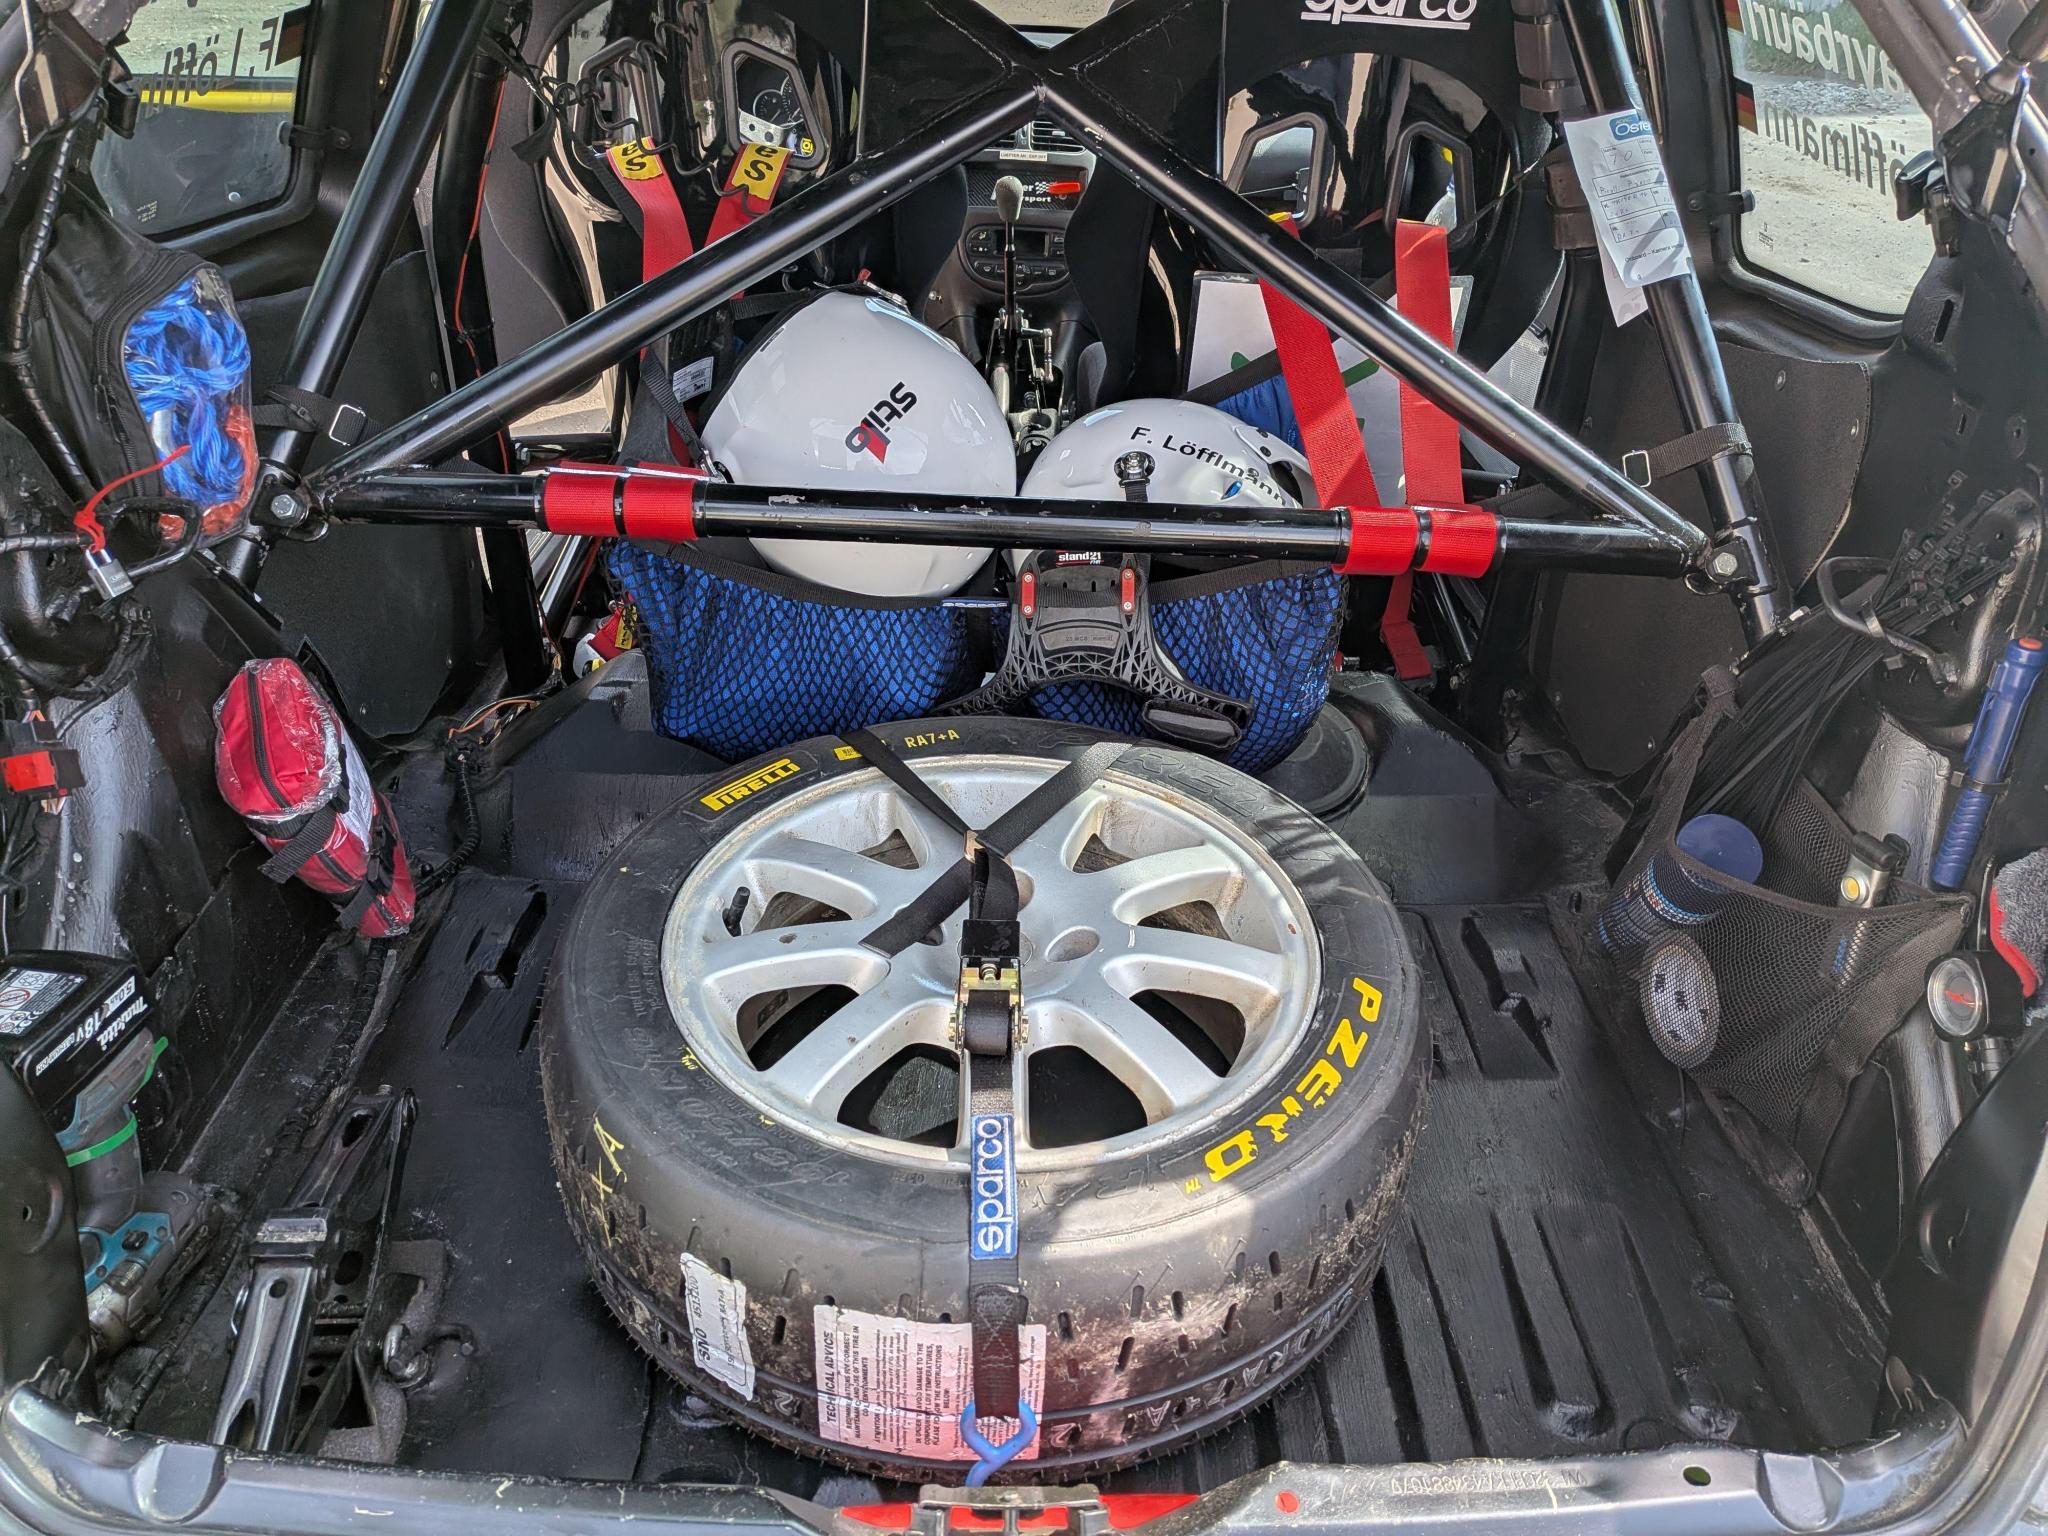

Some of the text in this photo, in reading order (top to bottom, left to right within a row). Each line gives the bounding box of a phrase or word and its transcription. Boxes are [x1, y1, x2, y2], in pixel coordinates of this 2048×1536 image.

[1130, 426, 1287, 507] F. Löfflmann
[903, 728, 961, 750] RA7+A
[699, 757, 801, 812] PIRELLI
[977, 1117, 1011, 1252] sparco
[696, 1327, 710, 1361] SNO
[824, 1331, 837, 1423] TECHICAL ADVICE
